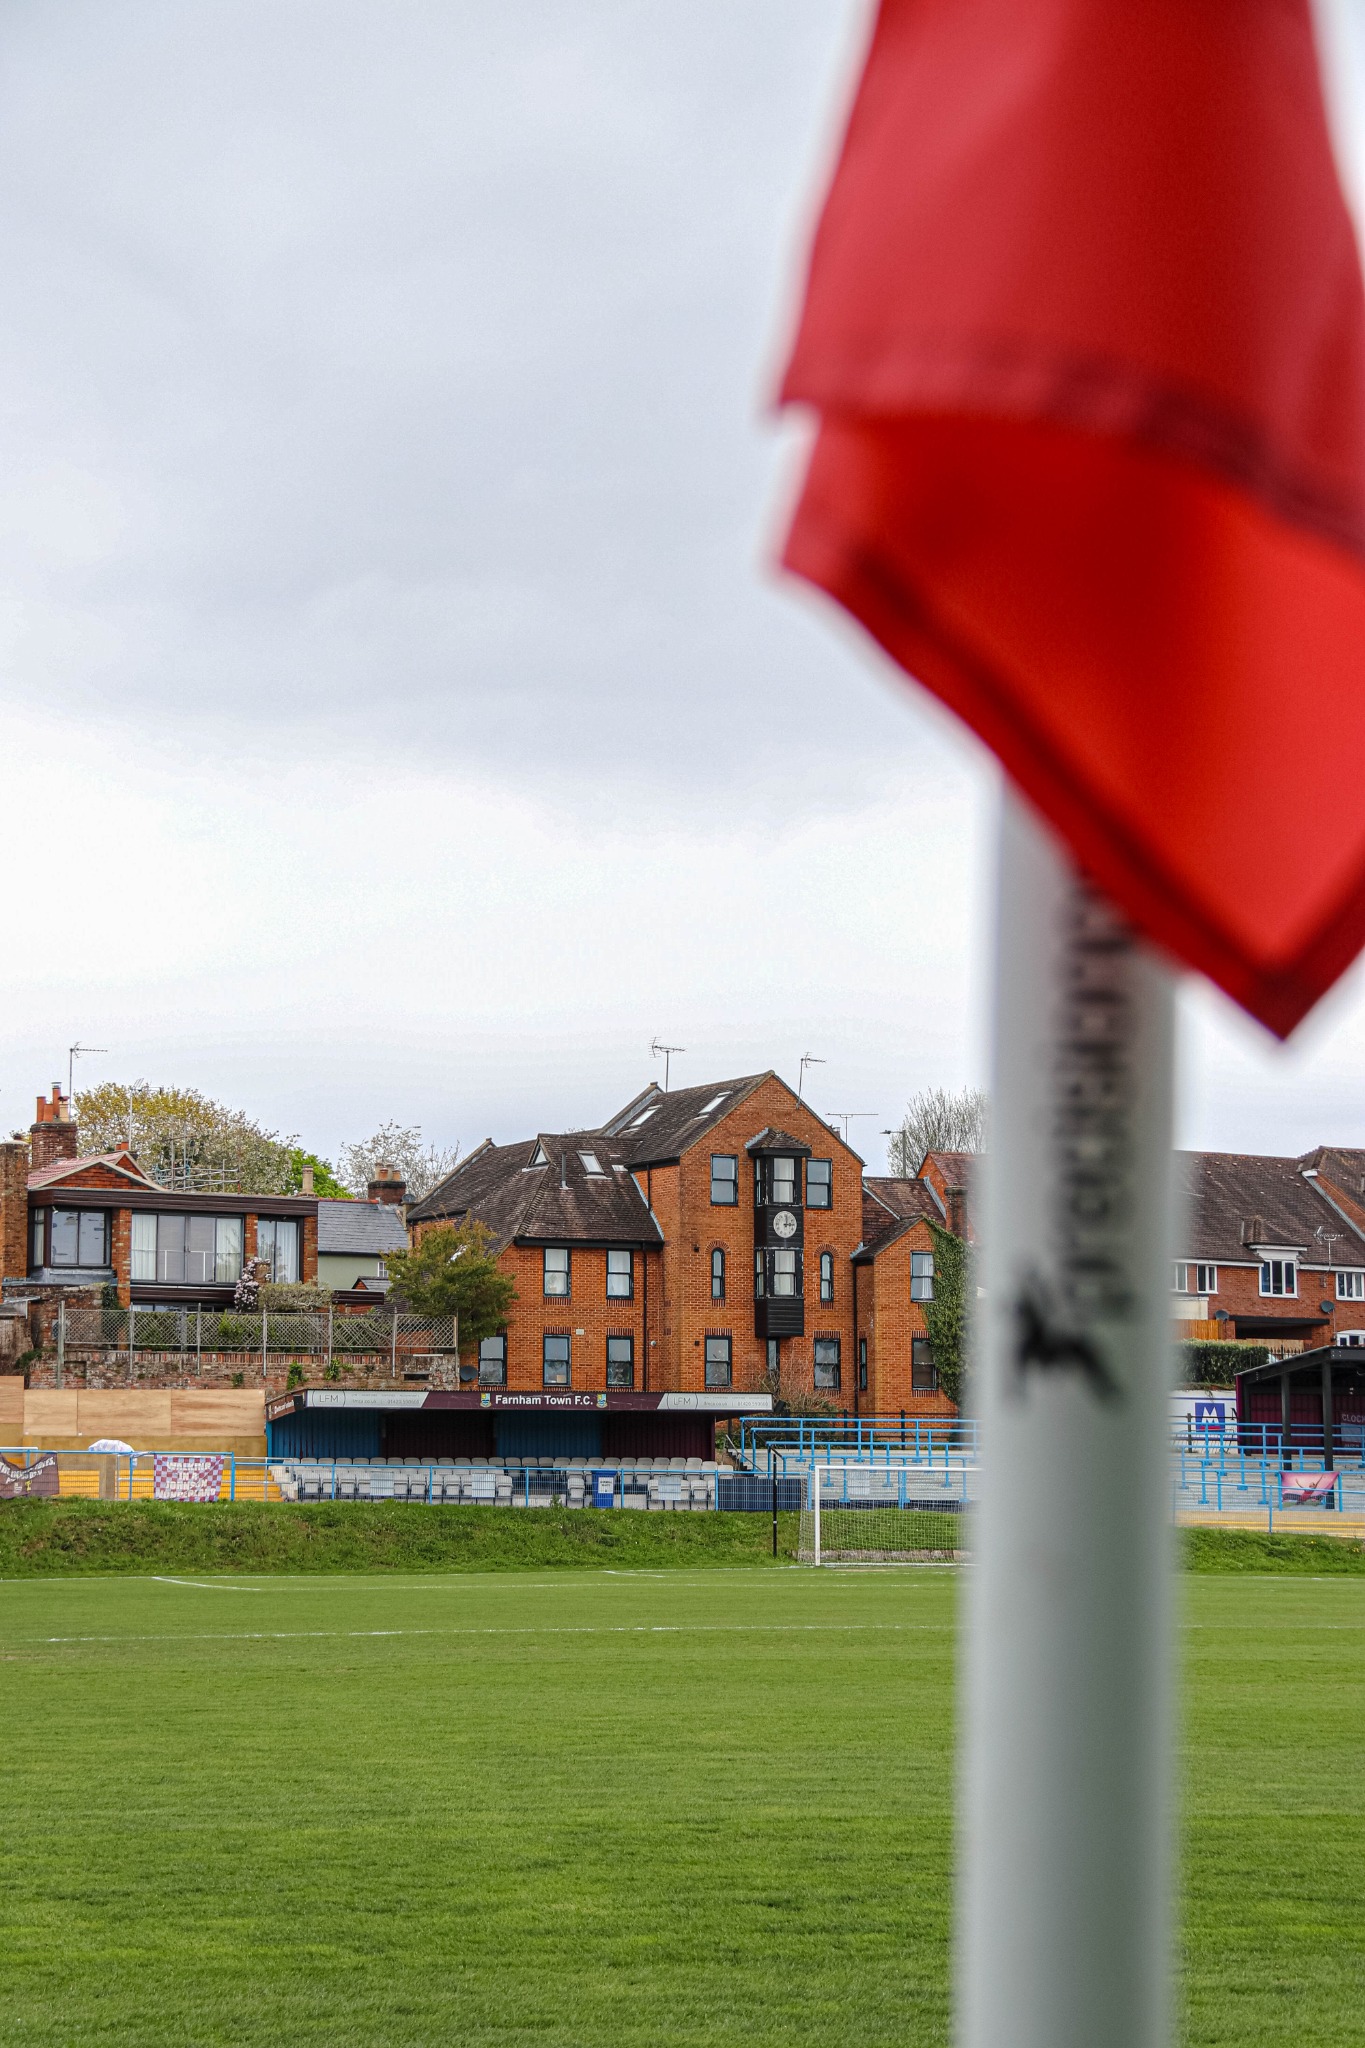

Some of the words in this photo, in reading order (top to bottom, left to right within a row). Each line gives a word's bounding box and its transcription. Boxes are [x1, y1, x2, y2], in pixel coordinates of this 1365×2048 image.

[319, 1394, 339, 1403] LFM
[495, 1394, 542, 1405] Farnham
[544, 1395, 572, 1405] Town
[574, 1395, 594, 1405] F.C.
[673, 1396, 691, 1406] LFM
[167, 1461, 212, 1471] WALKING
[178, 1472, 190, 1481] IN
